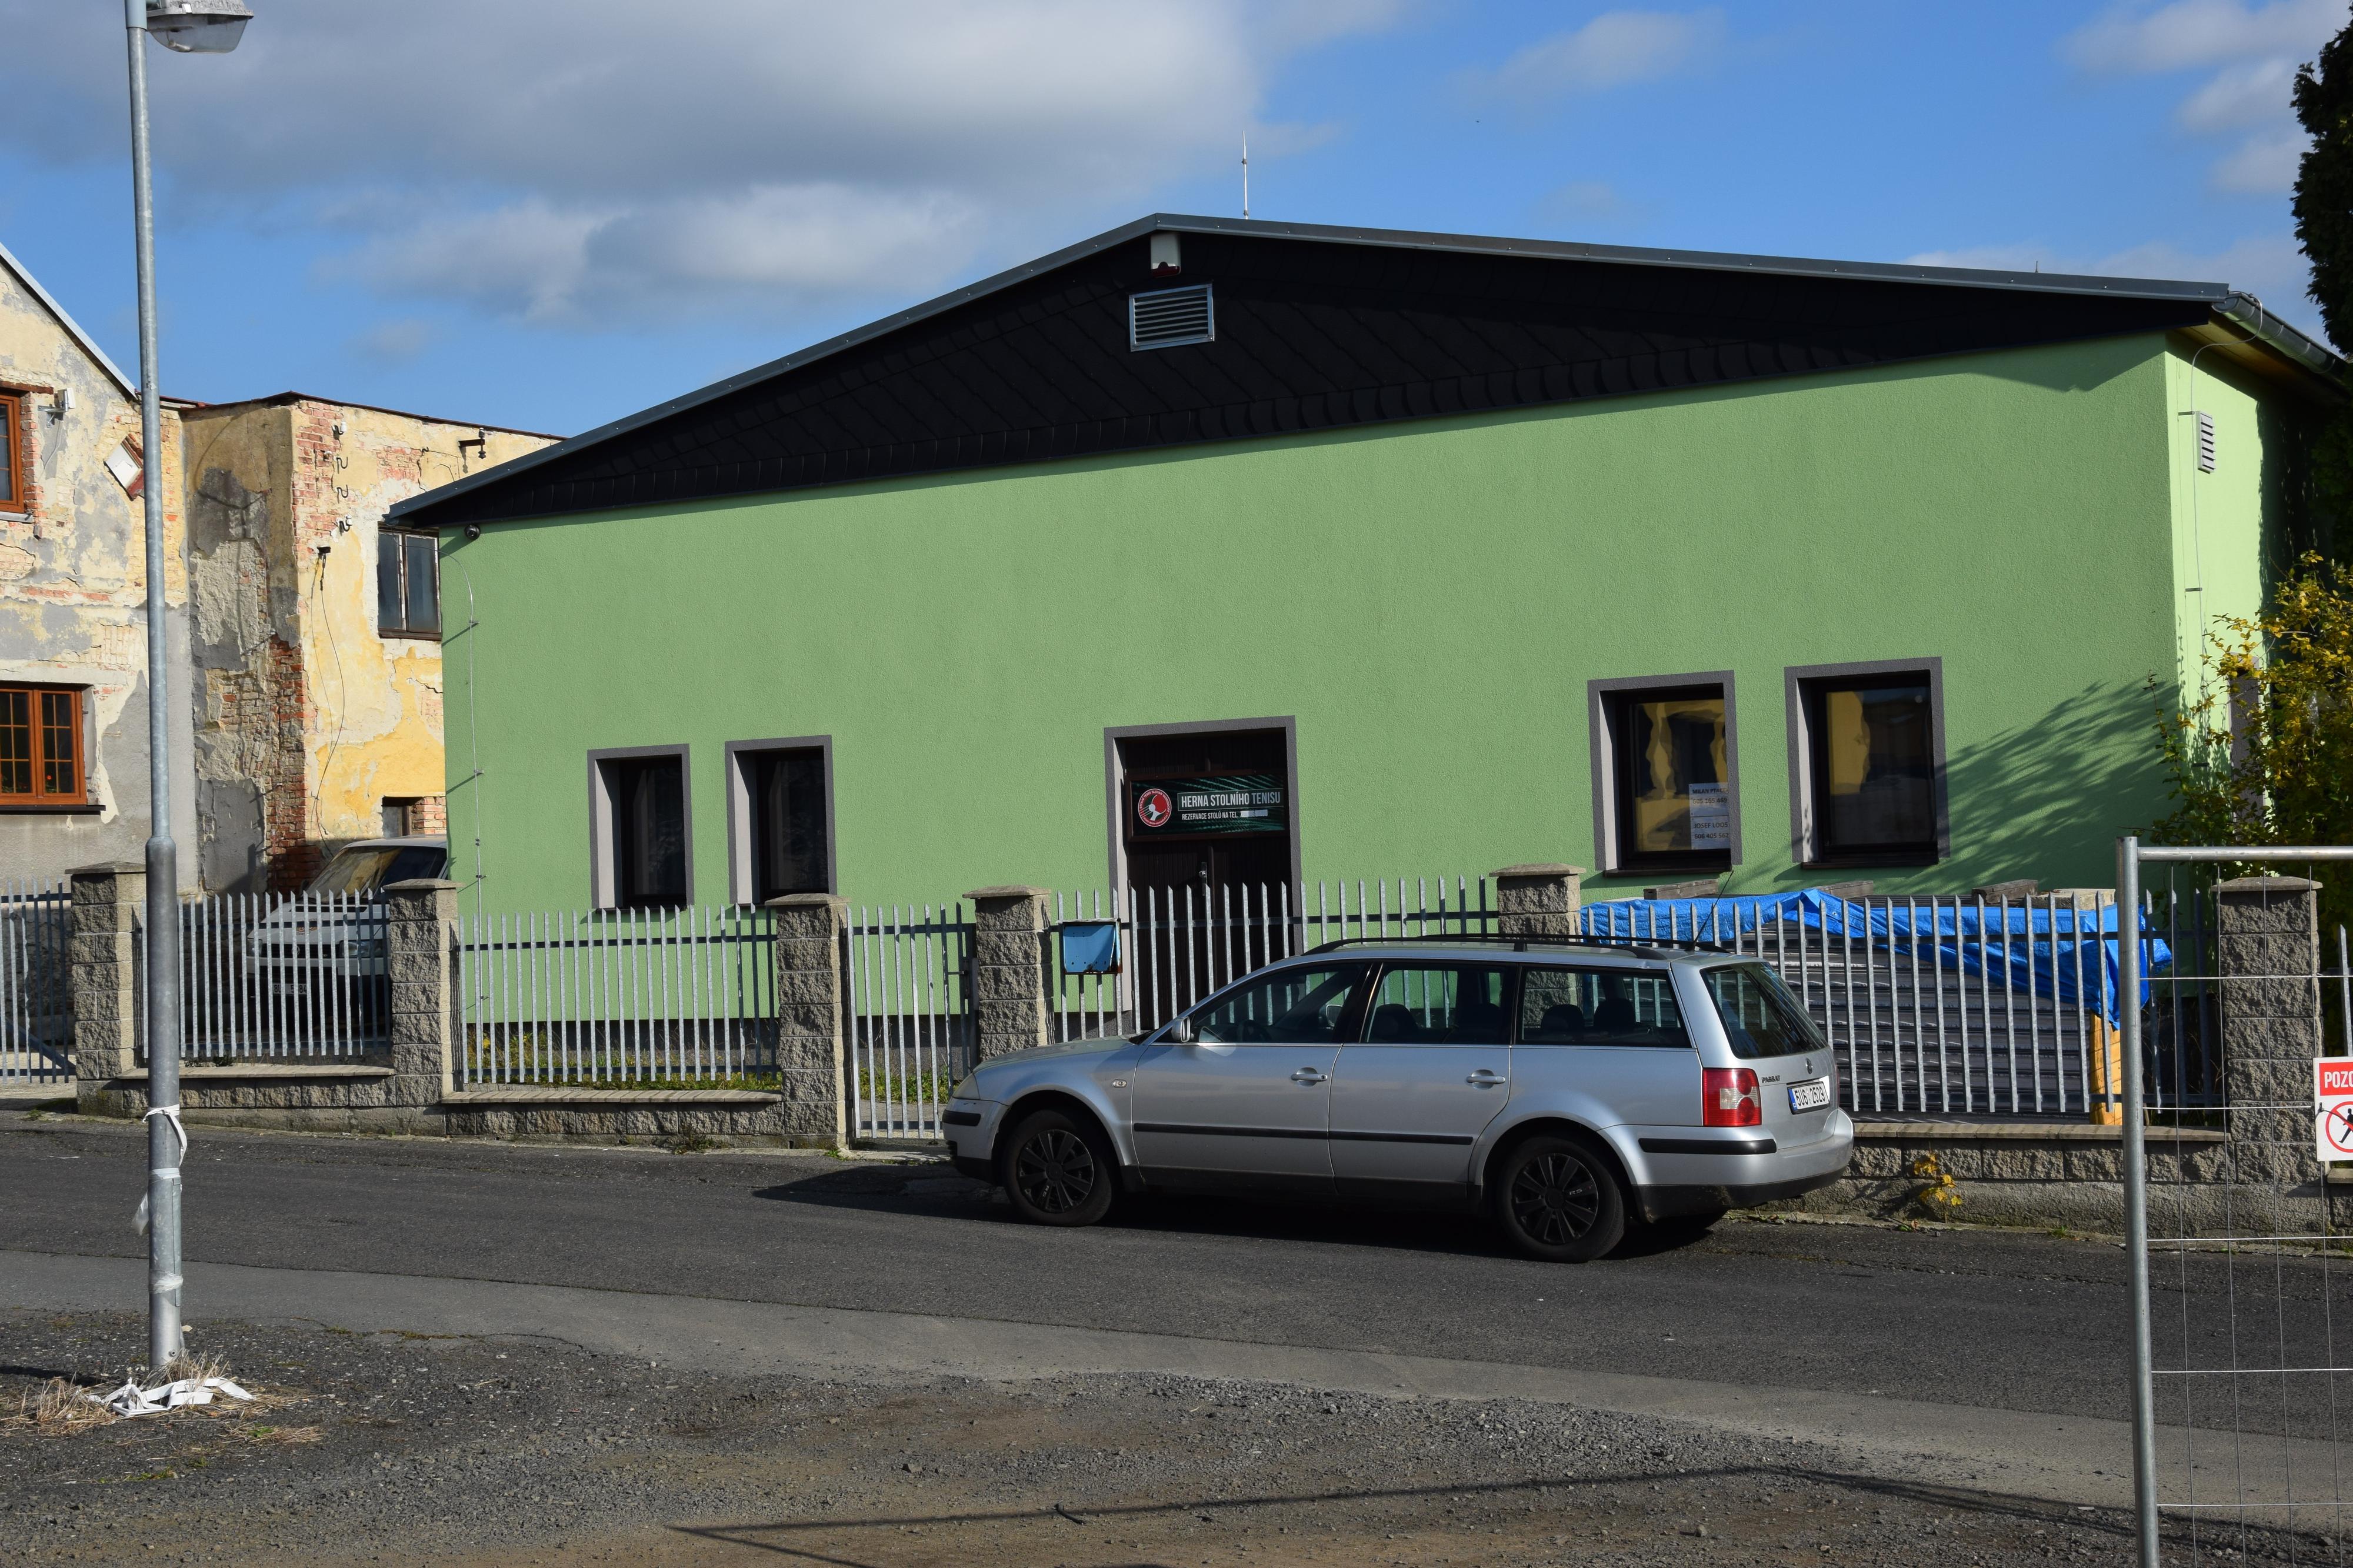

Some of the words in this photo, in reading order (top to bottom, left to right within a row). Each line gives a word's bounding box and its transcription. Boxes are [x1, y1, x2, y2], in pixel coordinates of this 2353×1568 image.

[1181, 795, 1209, 808] HERNA
[1210, 791, 1249, 806] STOLNÍHO
[1251, 792, 1281, 805] TENISU
[1208, 810, 1222, 819] STOLŮ
[1794, 1089, 1808, 1106] 5U6
[1810, 1086, 1825, 1103] 2529
